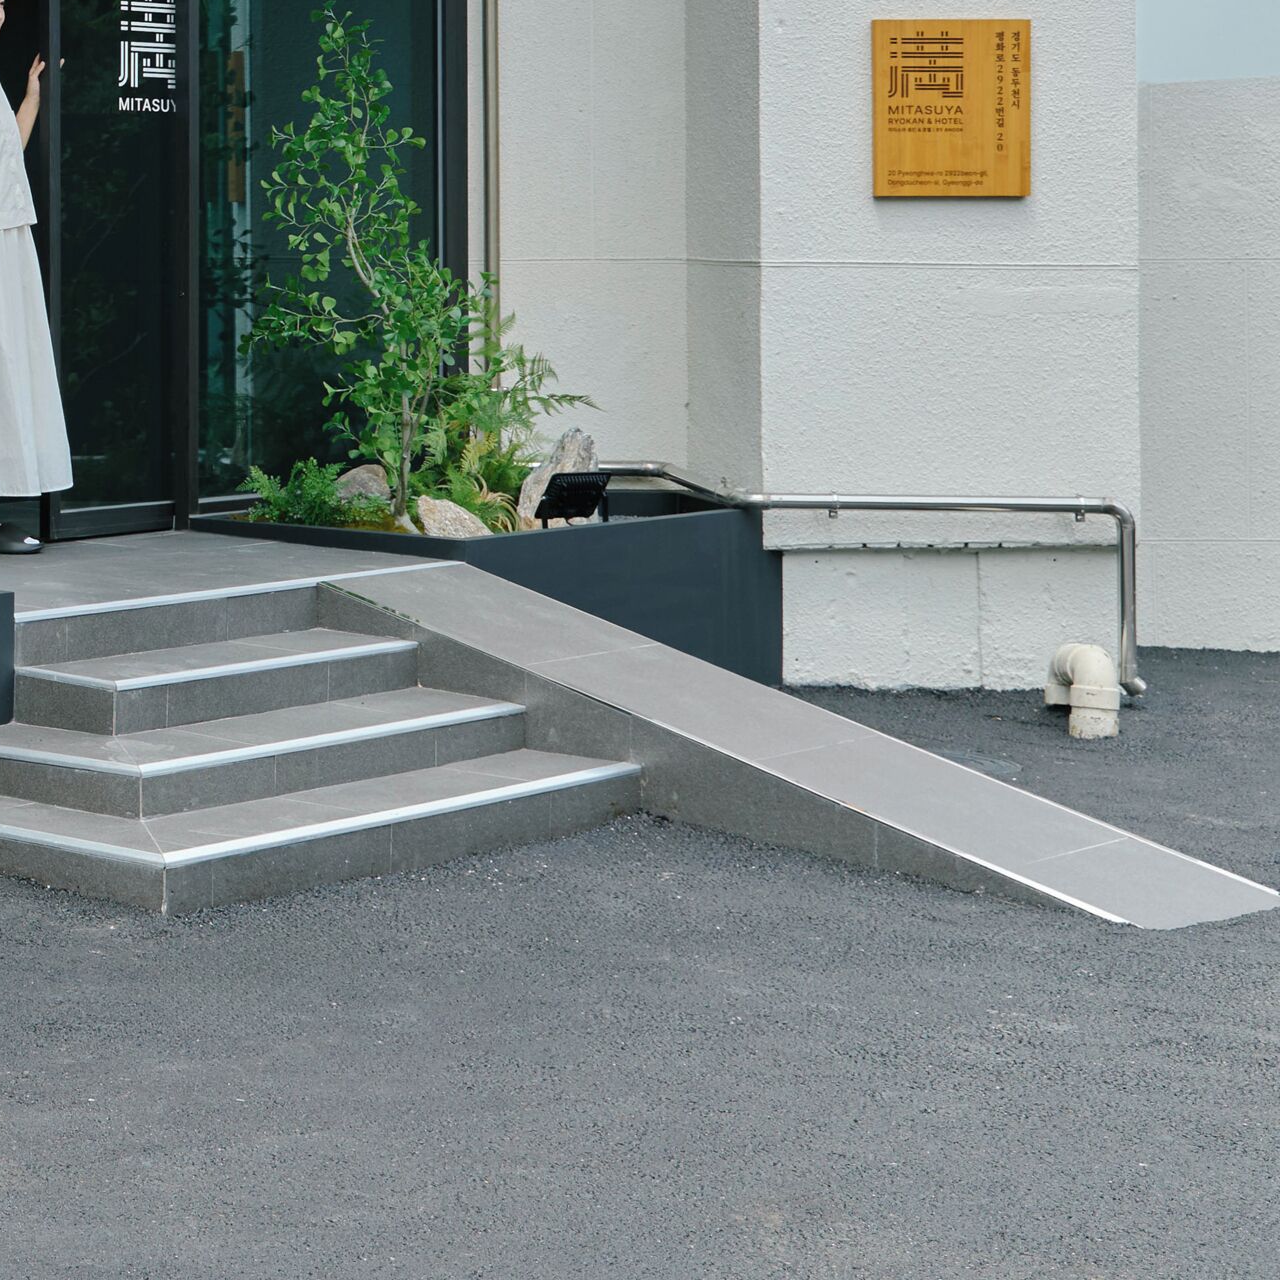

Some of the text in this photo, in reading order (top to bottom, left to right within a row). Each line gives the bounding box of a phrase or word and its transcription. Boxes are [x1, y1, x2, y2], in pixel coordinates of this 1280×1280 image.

[1011, 30, 1021, 111] 경기도 동두천시
[888, 105, 964, 115] MITASUYA
[996, 132, 1004, 153] 20
